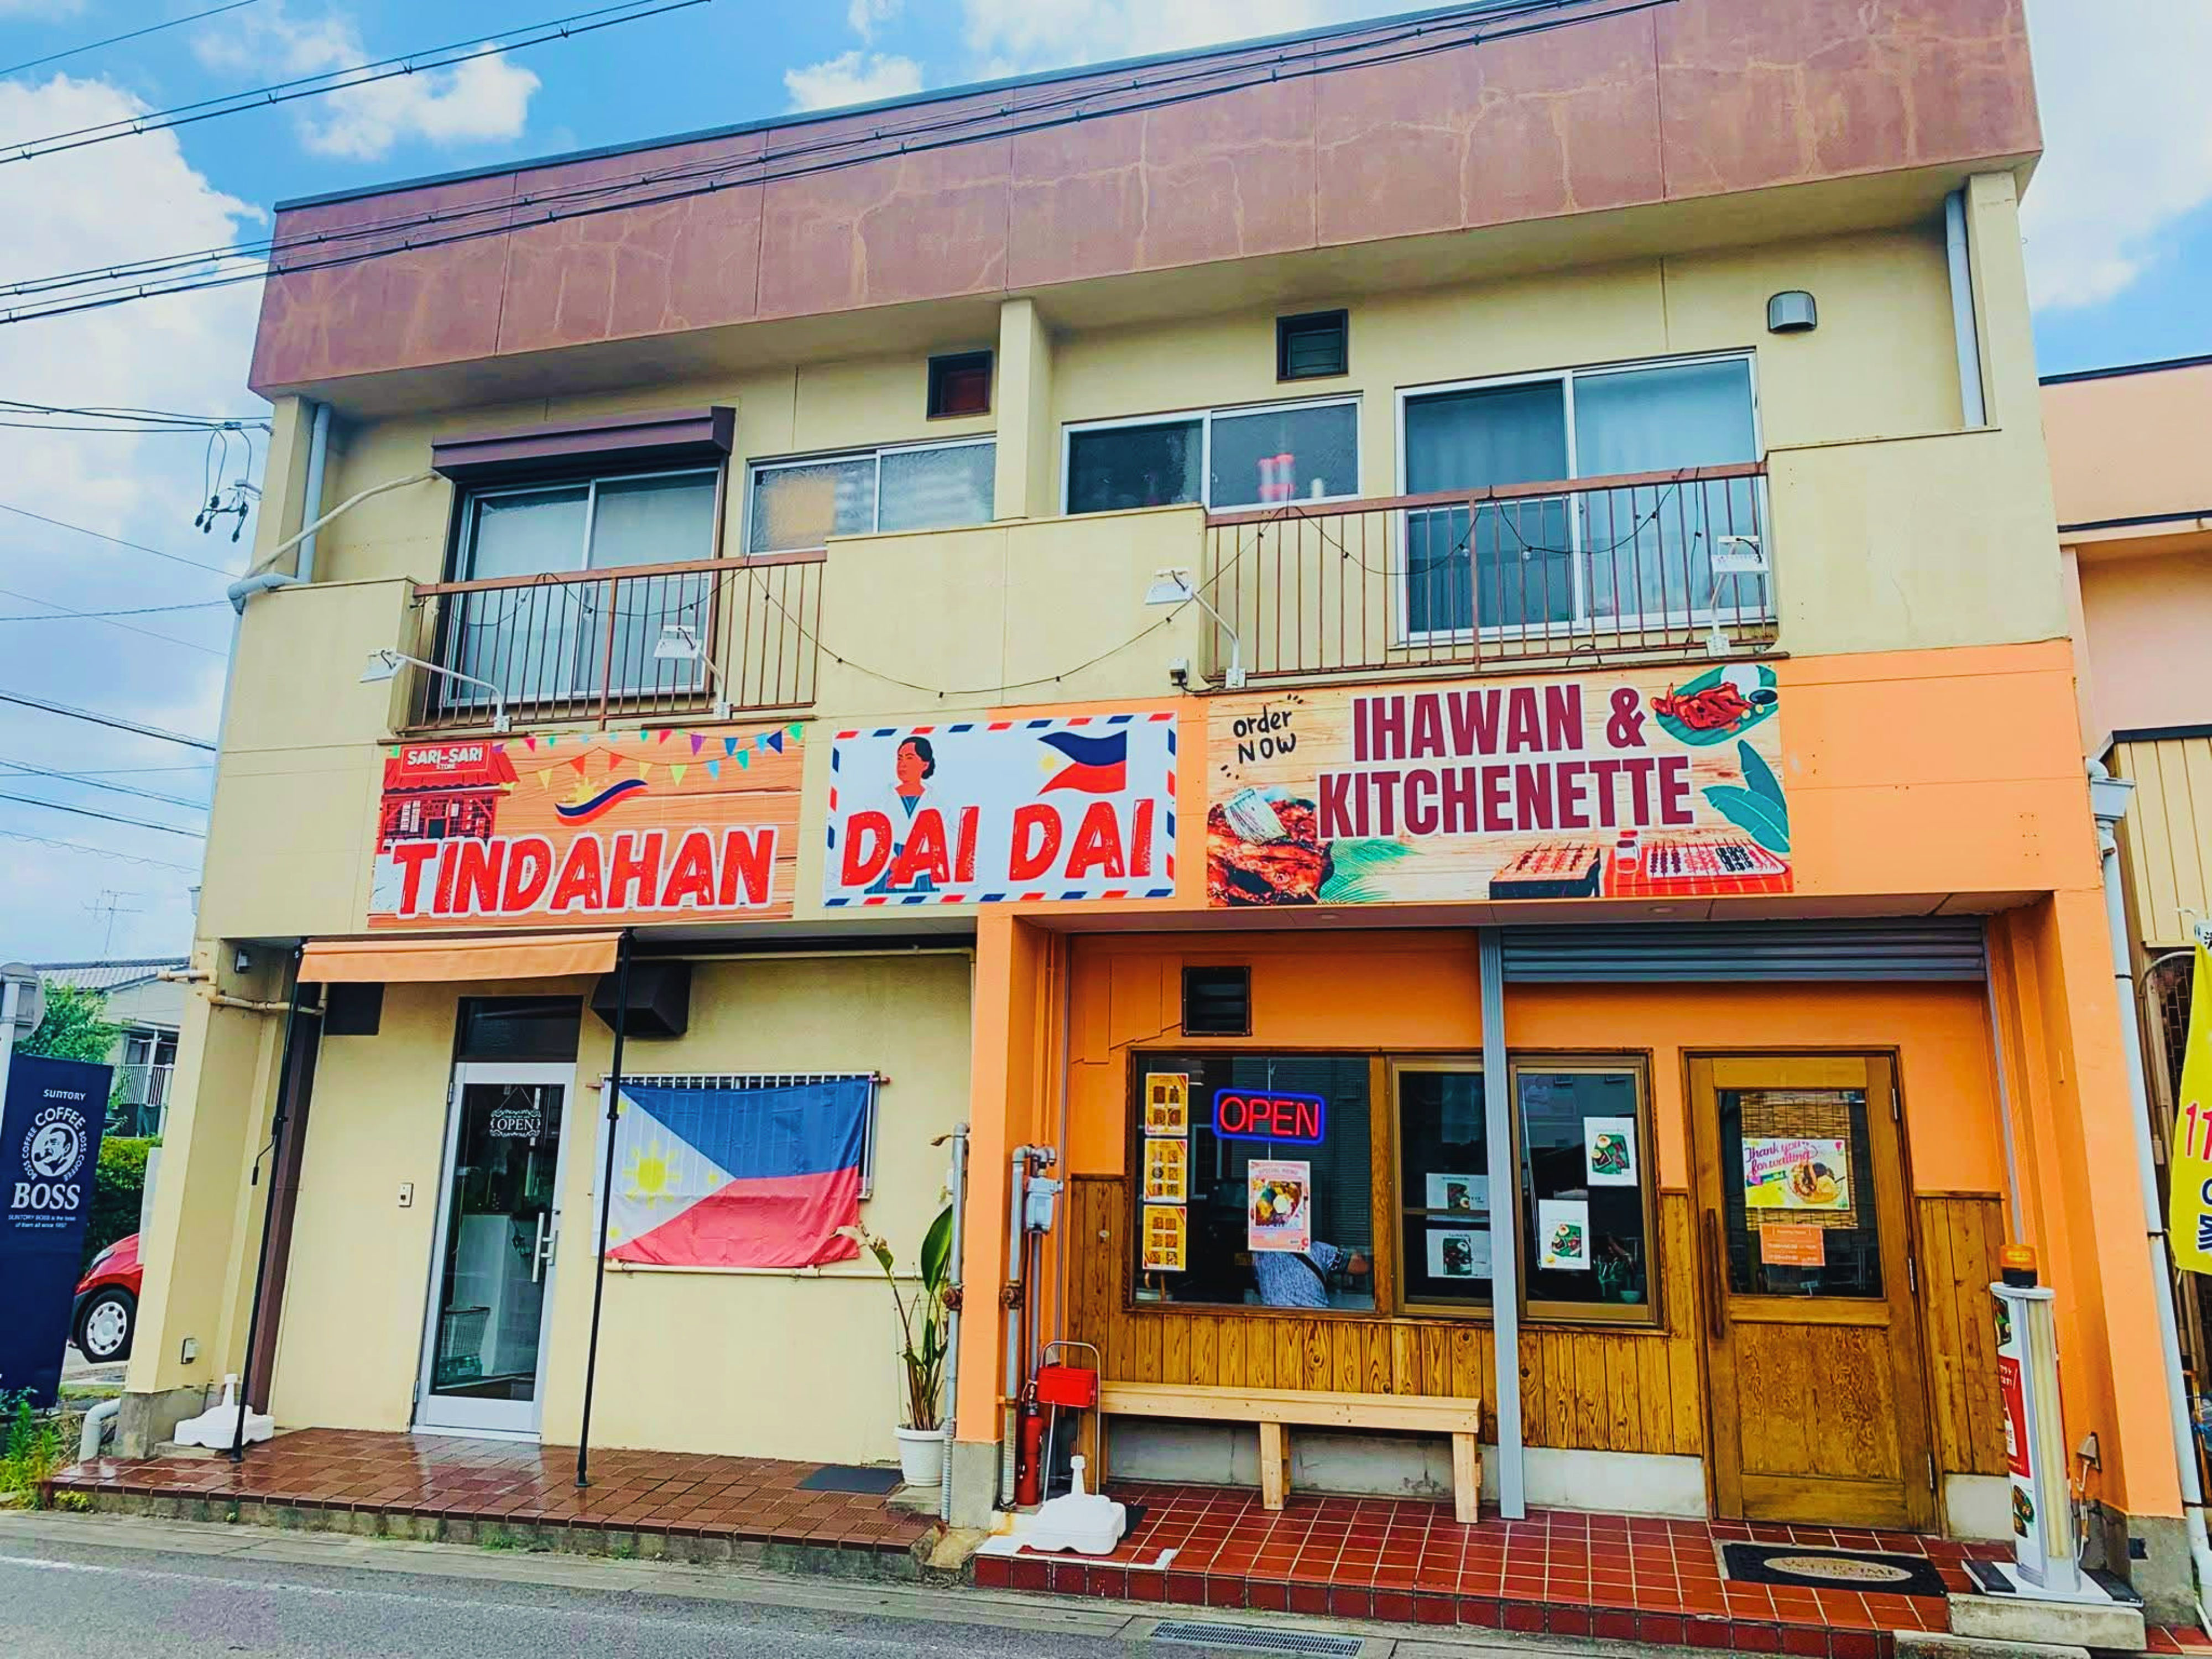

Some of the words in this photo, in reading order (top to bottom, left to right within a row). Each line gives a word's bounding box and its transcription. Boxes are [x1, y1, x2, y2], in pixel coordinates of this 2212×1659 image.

[1233, 706, 1292, 737] order
[1353, 684, 1584, 763] IHAWAN
[1605, 687, 1646, 749] &
[408, 747, 483, 765] SARI-SARI
[1238, 733, 1296, 764] NOW
[1319, 755, 1694, 838] KITCHENETTE
[841, 806, 979, 886] DAI
[1009, 799, 1154, 881] DAI
[393, 829, 778, 915] TINDAHAN
[43, 1089, 86, 1101] SUNTORY
[35, 1107, 86, 1130] COFFEE
[497, 1118, 534, 1130] OPEN
[1219, 1097, 1320, 1138] OPEN
[22, 1126, 38, 1159] COFFEE
[1744, 1141, 1780, 1163] Thank
[11, 1182, 80, 1210] BOSS
